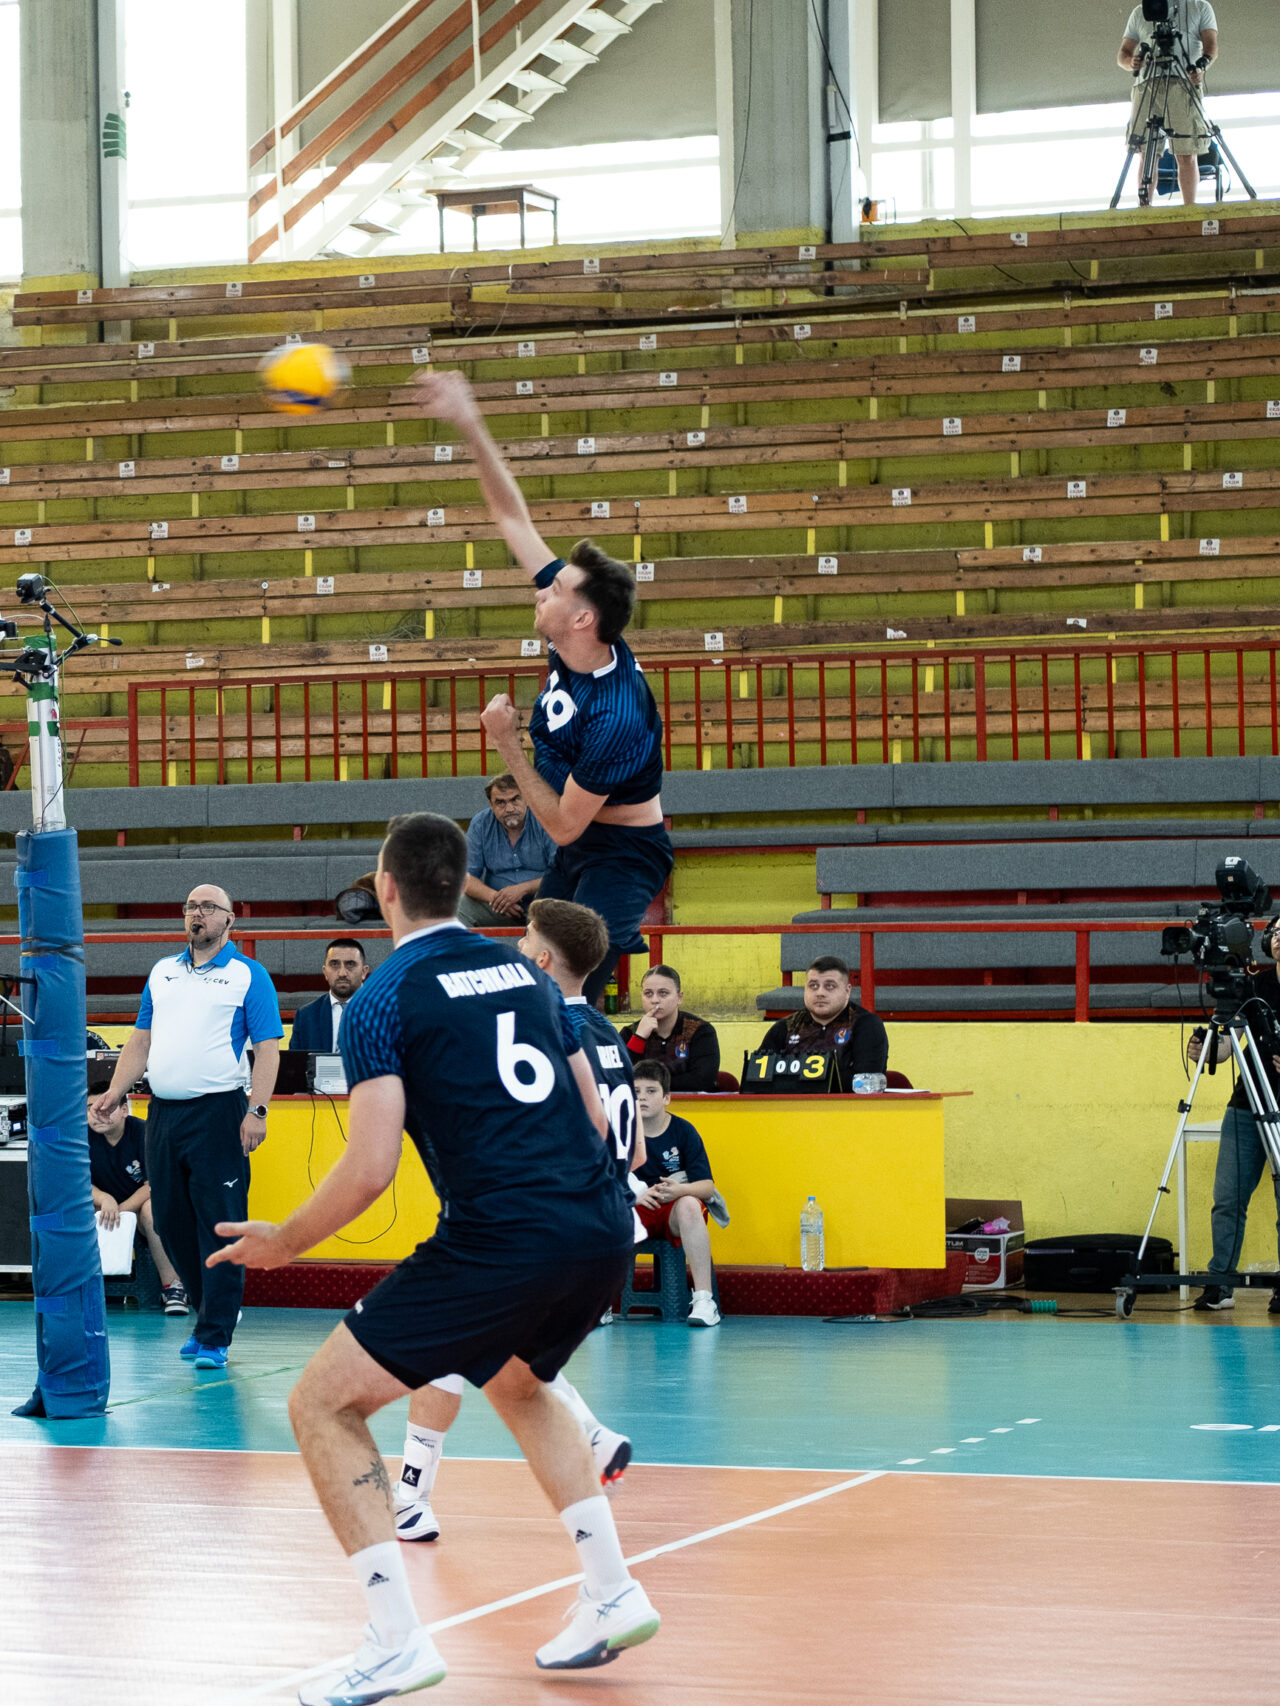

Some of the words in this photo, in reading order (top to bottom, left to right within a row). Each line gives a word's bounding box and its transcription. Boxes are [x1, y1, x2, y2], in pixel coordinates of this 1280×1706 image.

[496, 1010, 555, 1103] 6
[755, 1055, 769, 1078] 1
[775, 1060, 787, 1073] 0
[789, 1060, 801, 1073] 0
[803, 1055, 825, 1078] 3
